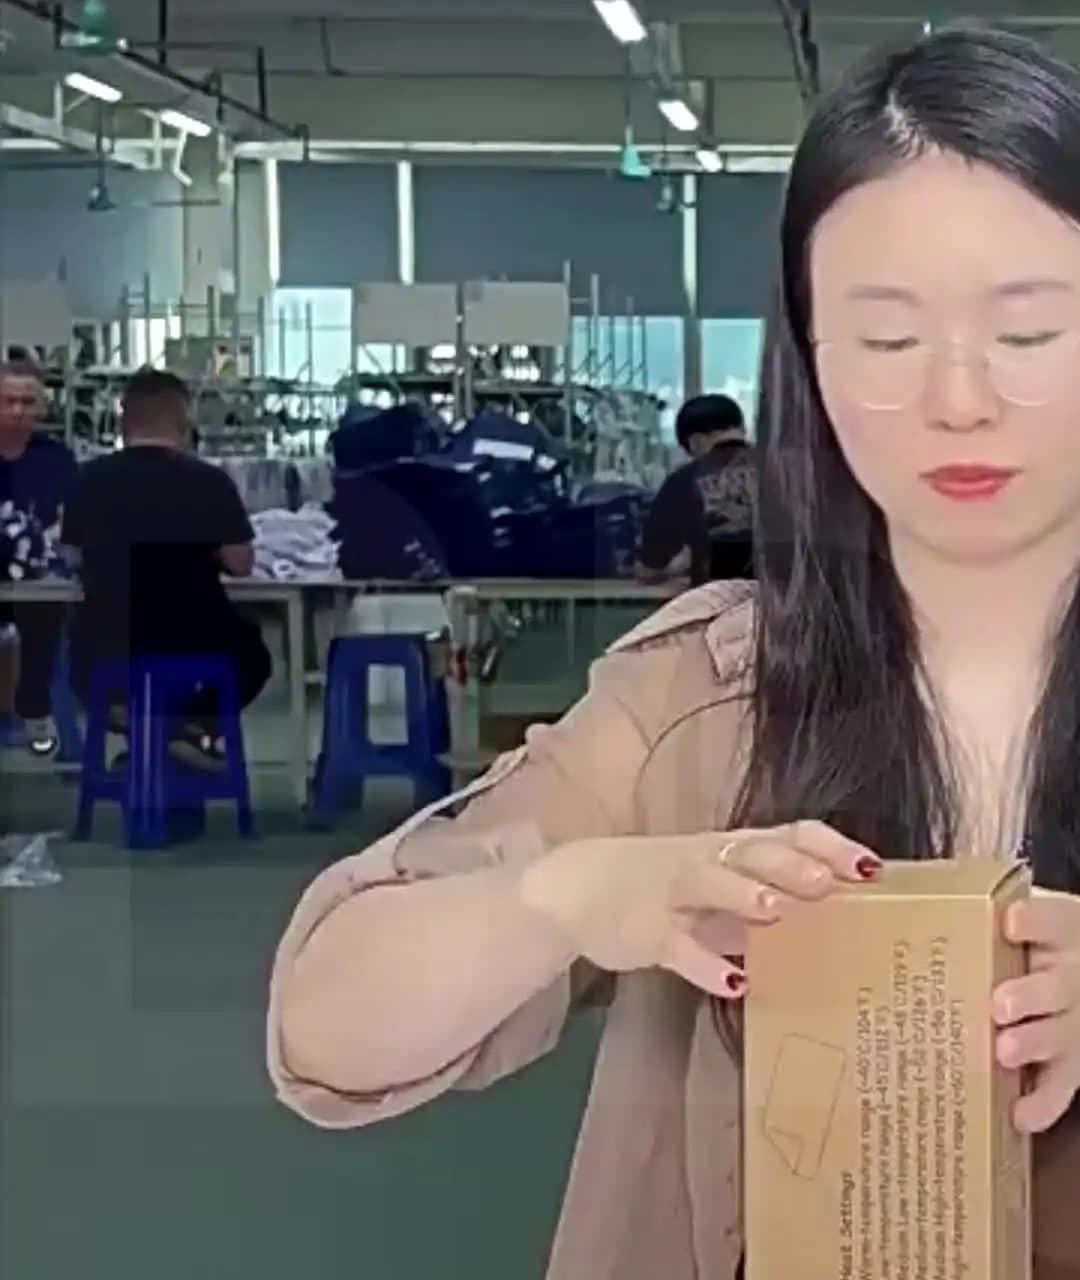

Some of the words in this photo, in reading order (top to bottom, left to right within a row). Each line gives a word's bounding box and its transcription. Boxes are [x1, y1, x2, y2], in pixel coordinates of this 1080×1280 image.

[860, 1098, 876, 1138] range
[914, 1086, 931, 1128] range
[879, 1114, 894, 1156] range
[952, 1110, 968, 1151] range
[839, 1170, 856, 1240] Settings
